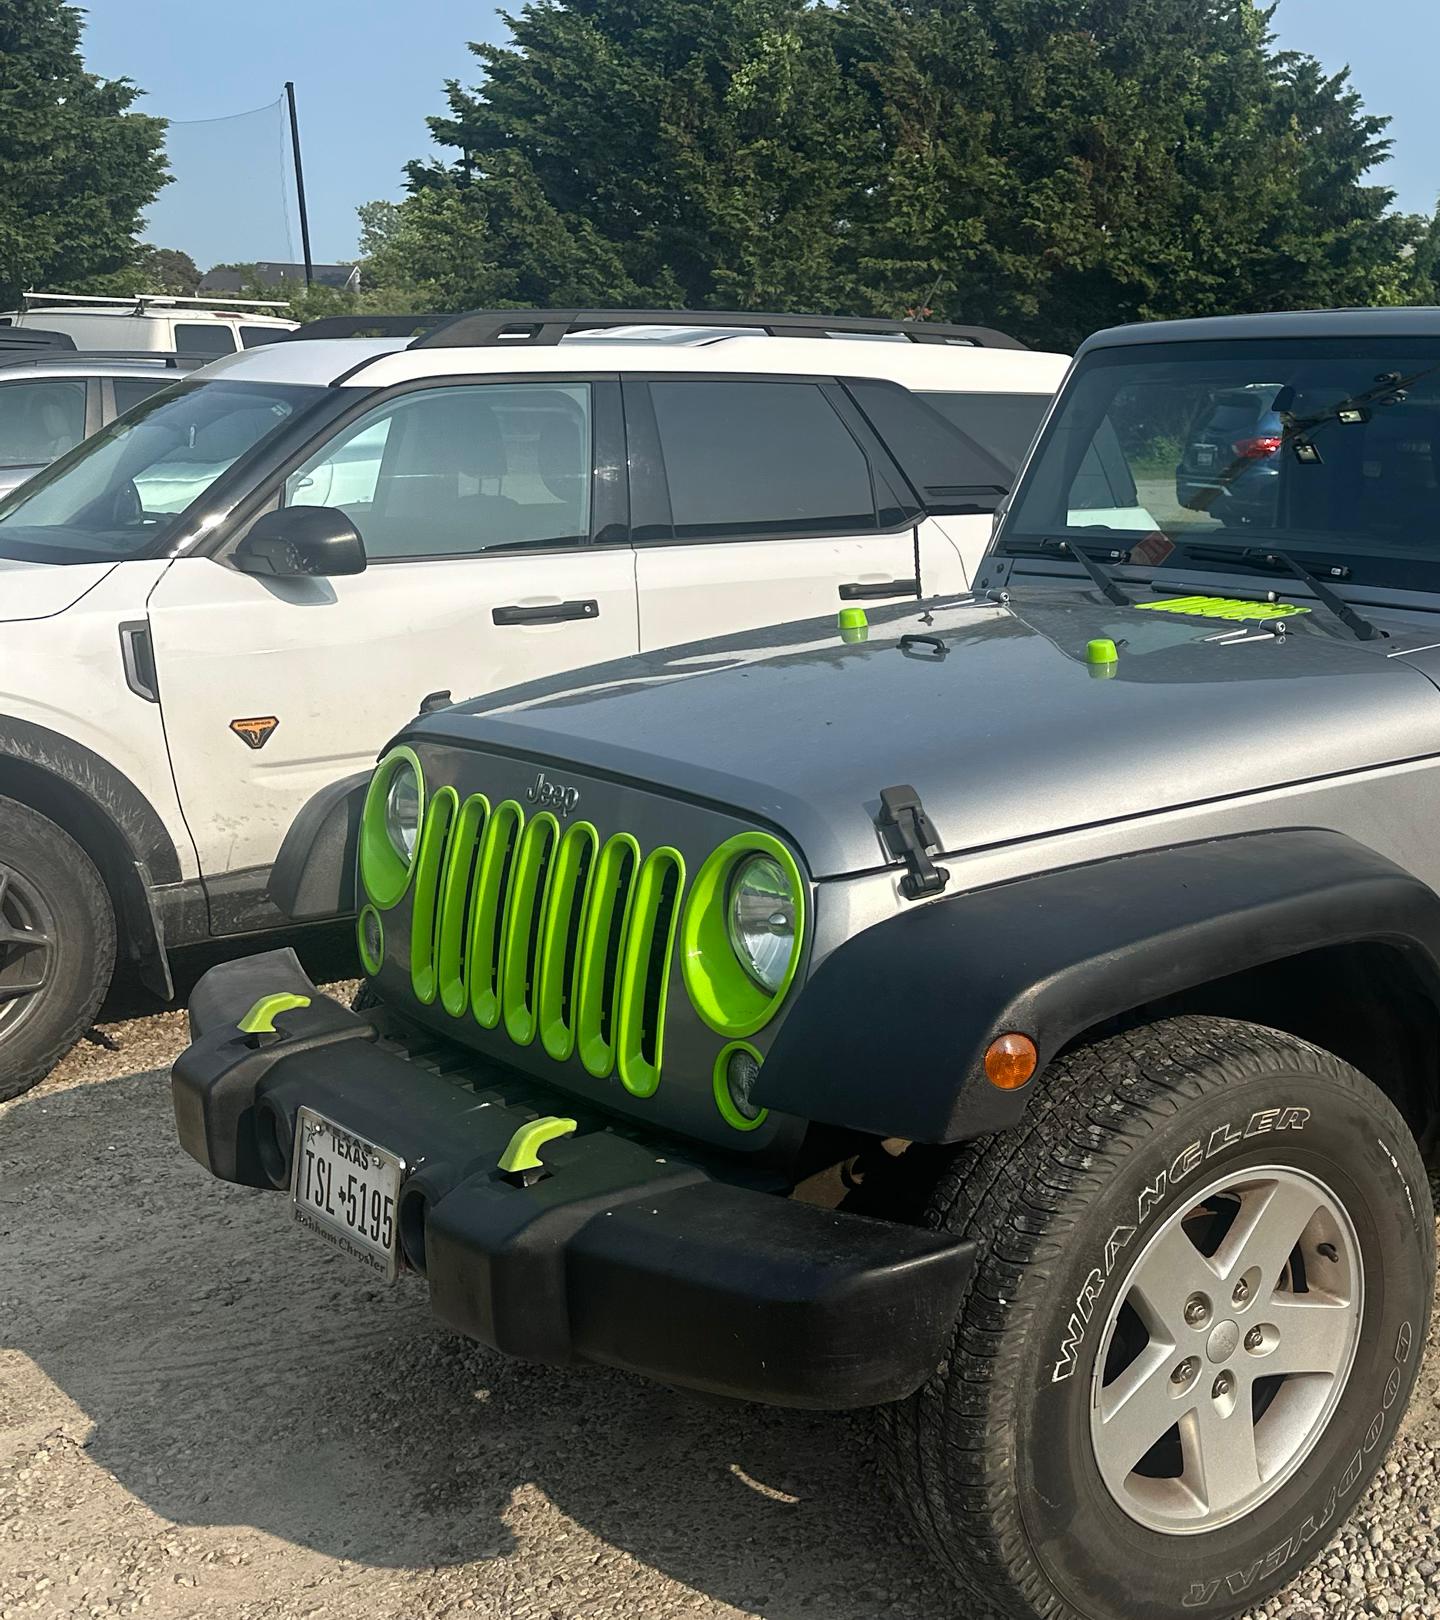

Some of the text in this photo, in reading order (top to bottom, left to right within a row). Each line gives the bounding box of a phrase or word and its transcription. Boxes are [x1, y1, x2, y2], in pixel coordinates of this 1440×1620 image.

[526, 773, 579, 818] Jeep
[331, 1136, 369, 1170] TEXAS
[338, 1236, 386, 1273] Chrysler
[1052, 1107, 1311, 1382] WRANGLER
[1182, 1320, 1412, 1608] GOODYEAR
